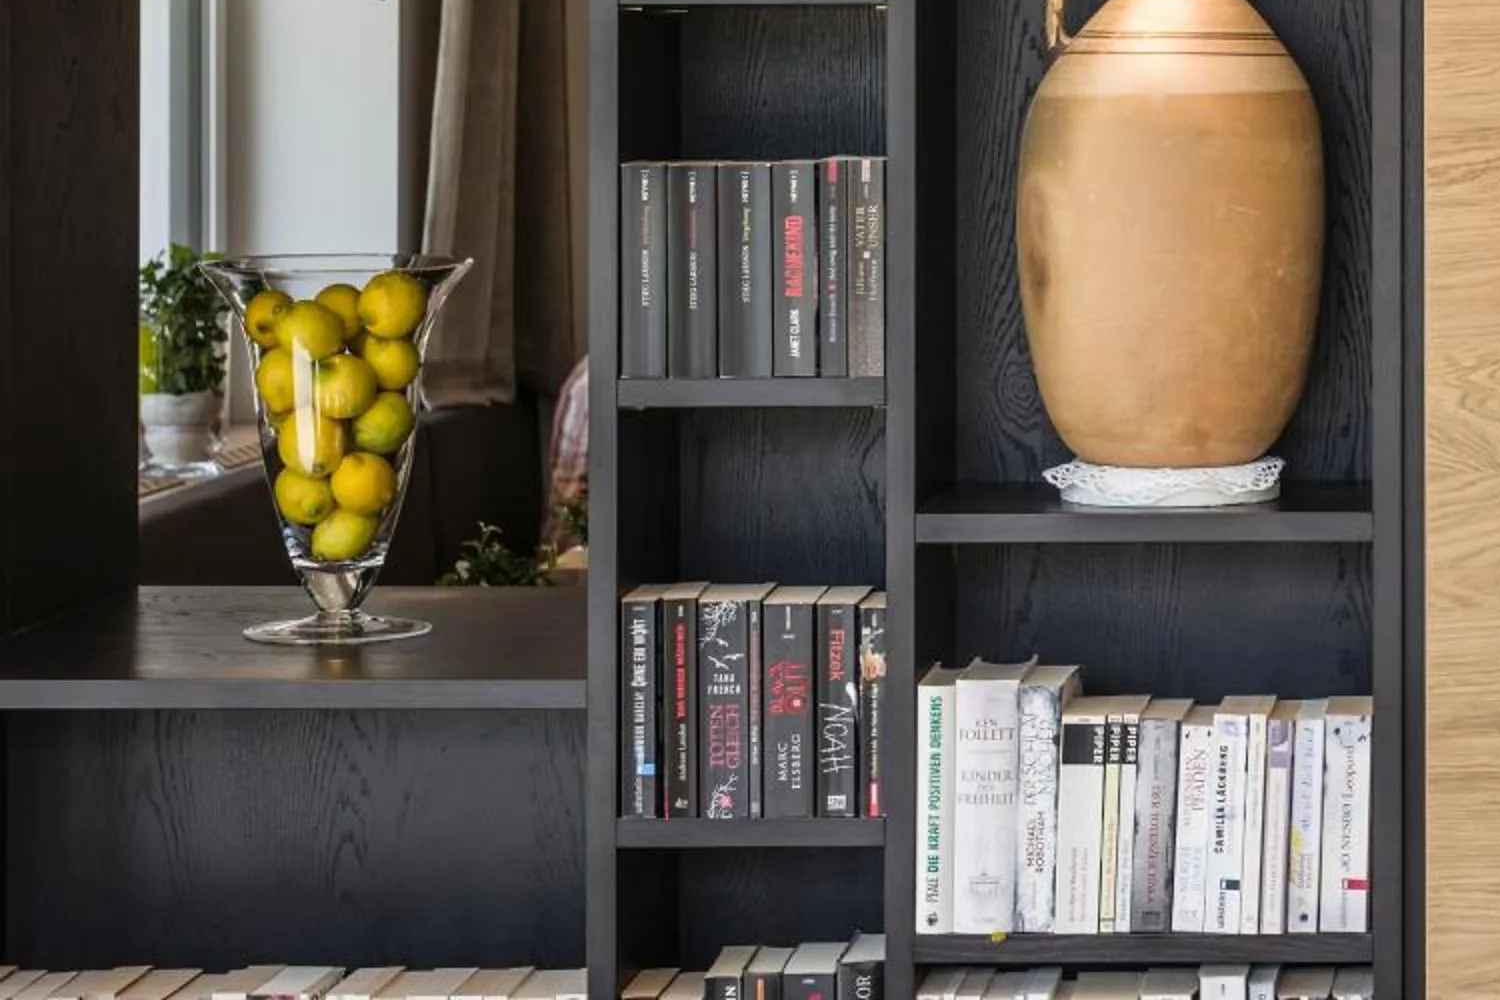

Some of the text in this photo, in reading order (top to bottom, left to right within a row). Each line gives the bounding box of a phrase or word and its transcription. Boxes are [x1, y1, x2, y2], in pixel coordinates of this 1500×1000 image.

[856, 207, 865, 247] VATER
[869, 205, 878, 247] UNSER
[830, 629, 845, 680] Fitzek
[709, 704, 724, 767] TOTEN
[726, 704, 740, 768] GLEICH
[929, 695, 943, 748] DENKENS
[778, 743, 787, 781] MARC
[791, 733, 801, 789] ELSBERG
[1109, 727, 1120, 763] PIPER
[1125, 727, 1137, 763] PIPER
[929, 752, 942, 810] POSITIVEN
[928, 814, 940, 848] KRAFT
[928, 853, 940, 873] DIE
